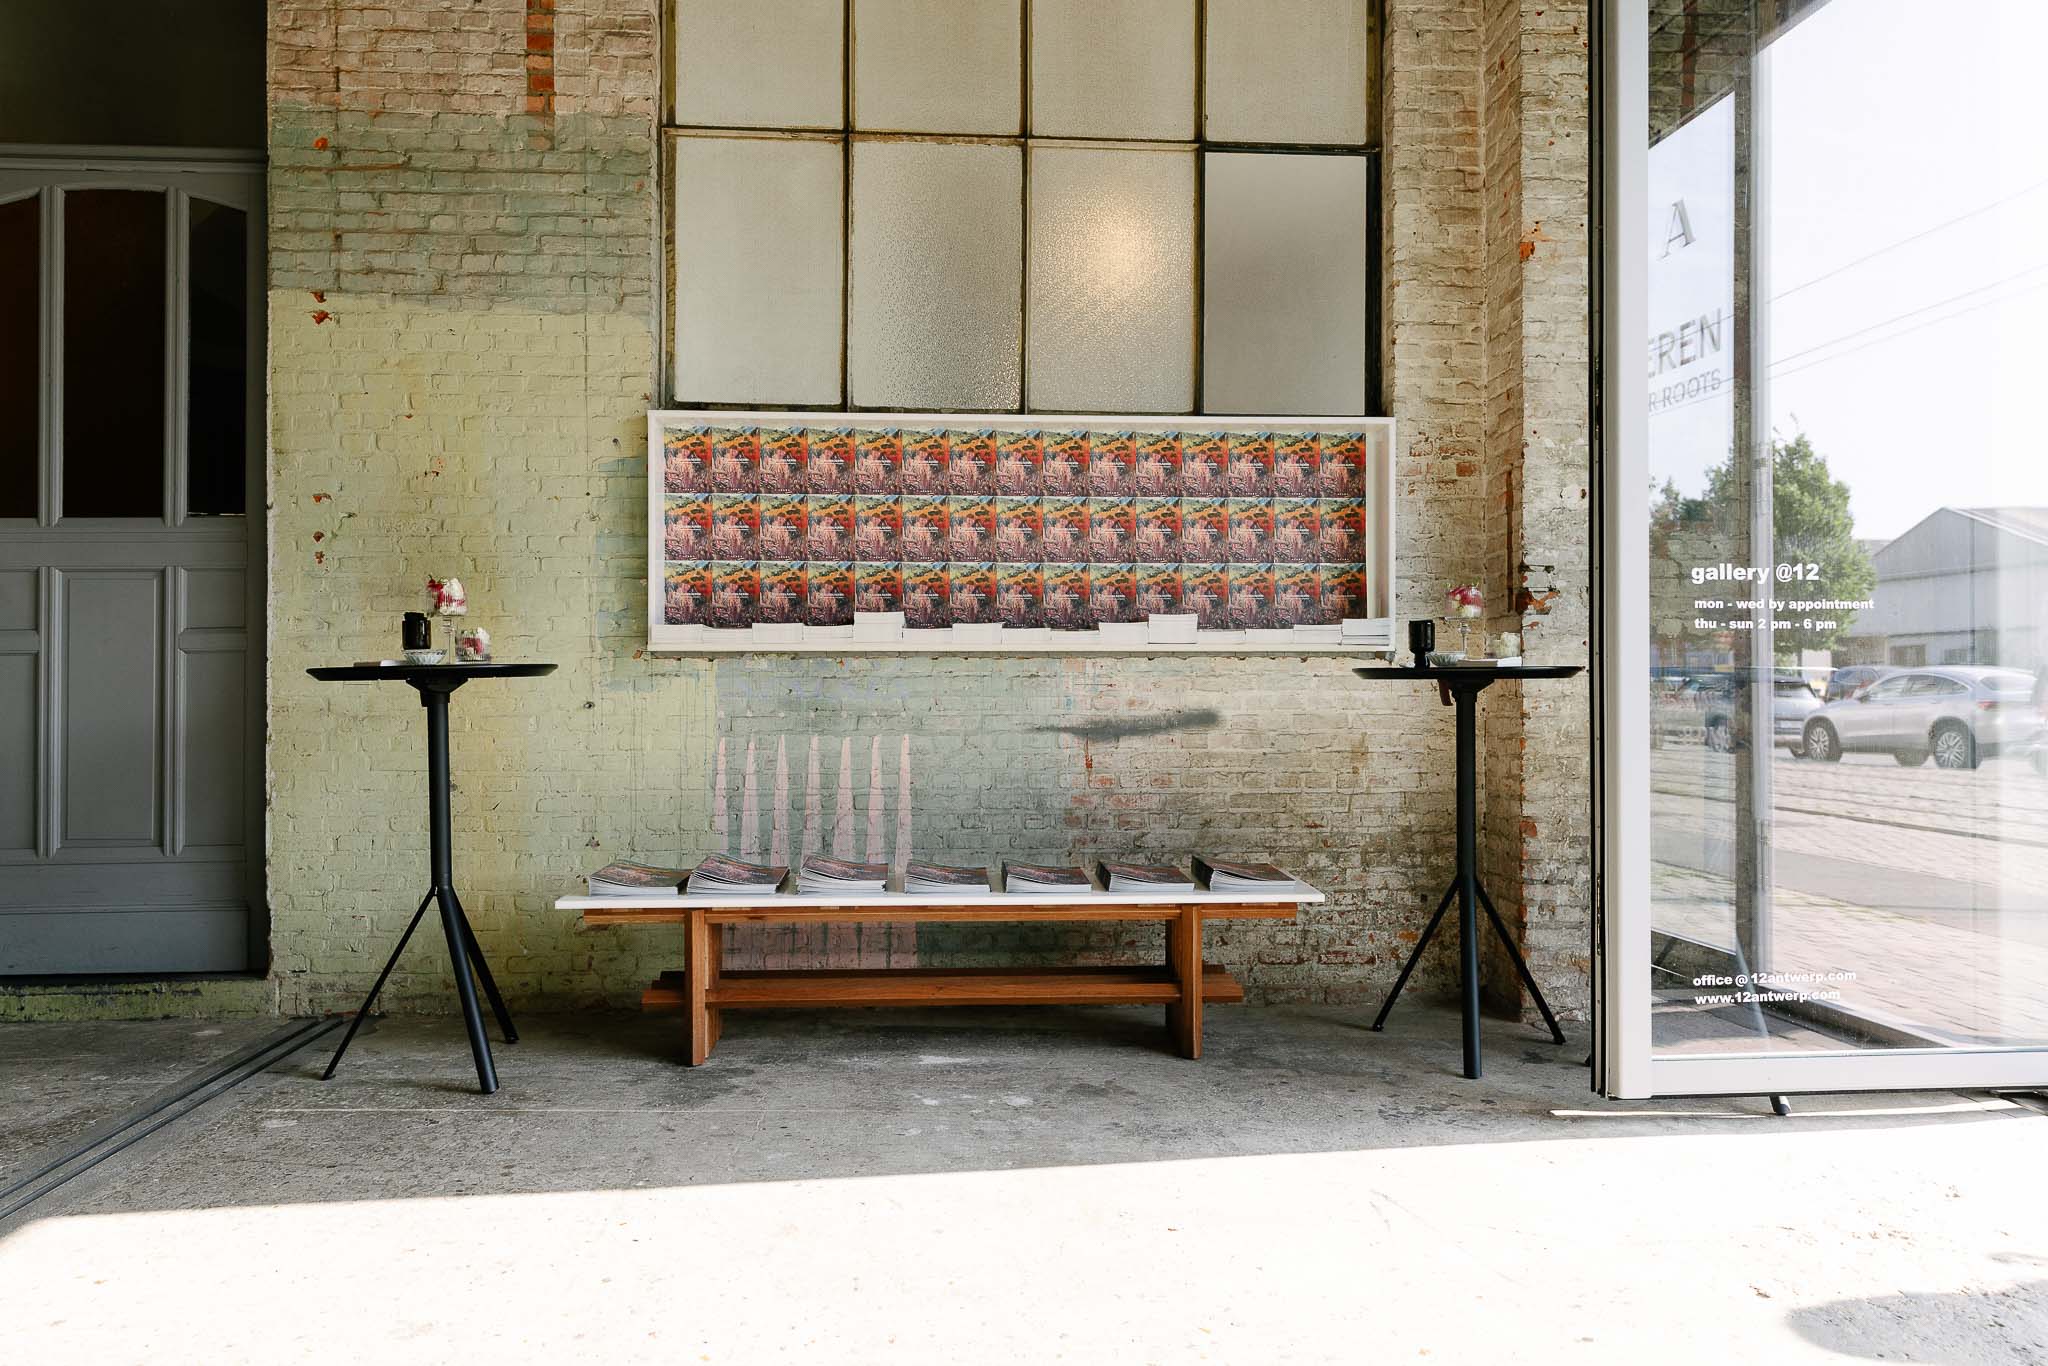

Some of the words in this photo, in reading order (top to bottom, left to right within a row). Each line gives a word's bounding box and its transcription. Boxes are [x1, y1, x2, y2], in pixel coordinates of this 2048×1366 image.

[1656, 199, 1696, 260] A
[1661, 368, 1721, 408] ROOTS
[1691, 563, 1770, 584] gallery
[1776, 563, 1820, 582] @12
[1694, 600, 1724, 609] mon
[1736, 599, 1765, 609] wed
[1769, 599, 1786, 611] by
[1788, 599, 1875, 611] appointment
[1694, 618, 1717, 629] thu
[1729, 621, 1754, 629] sun
[1758, 619, 1766, 629] 2
[1770, 621, 1791, 631] pm
[1803, 619, 1812, 629] 6
[1816, 621, 1837, 631] pm
[1693, 974, 1733, 987] office
[1735, 974, 1748, 987] @
[1752, 971, 1857, 985] 12antwerp.com
[1694, 990, 1841, 1004] www.12antwerp.com
